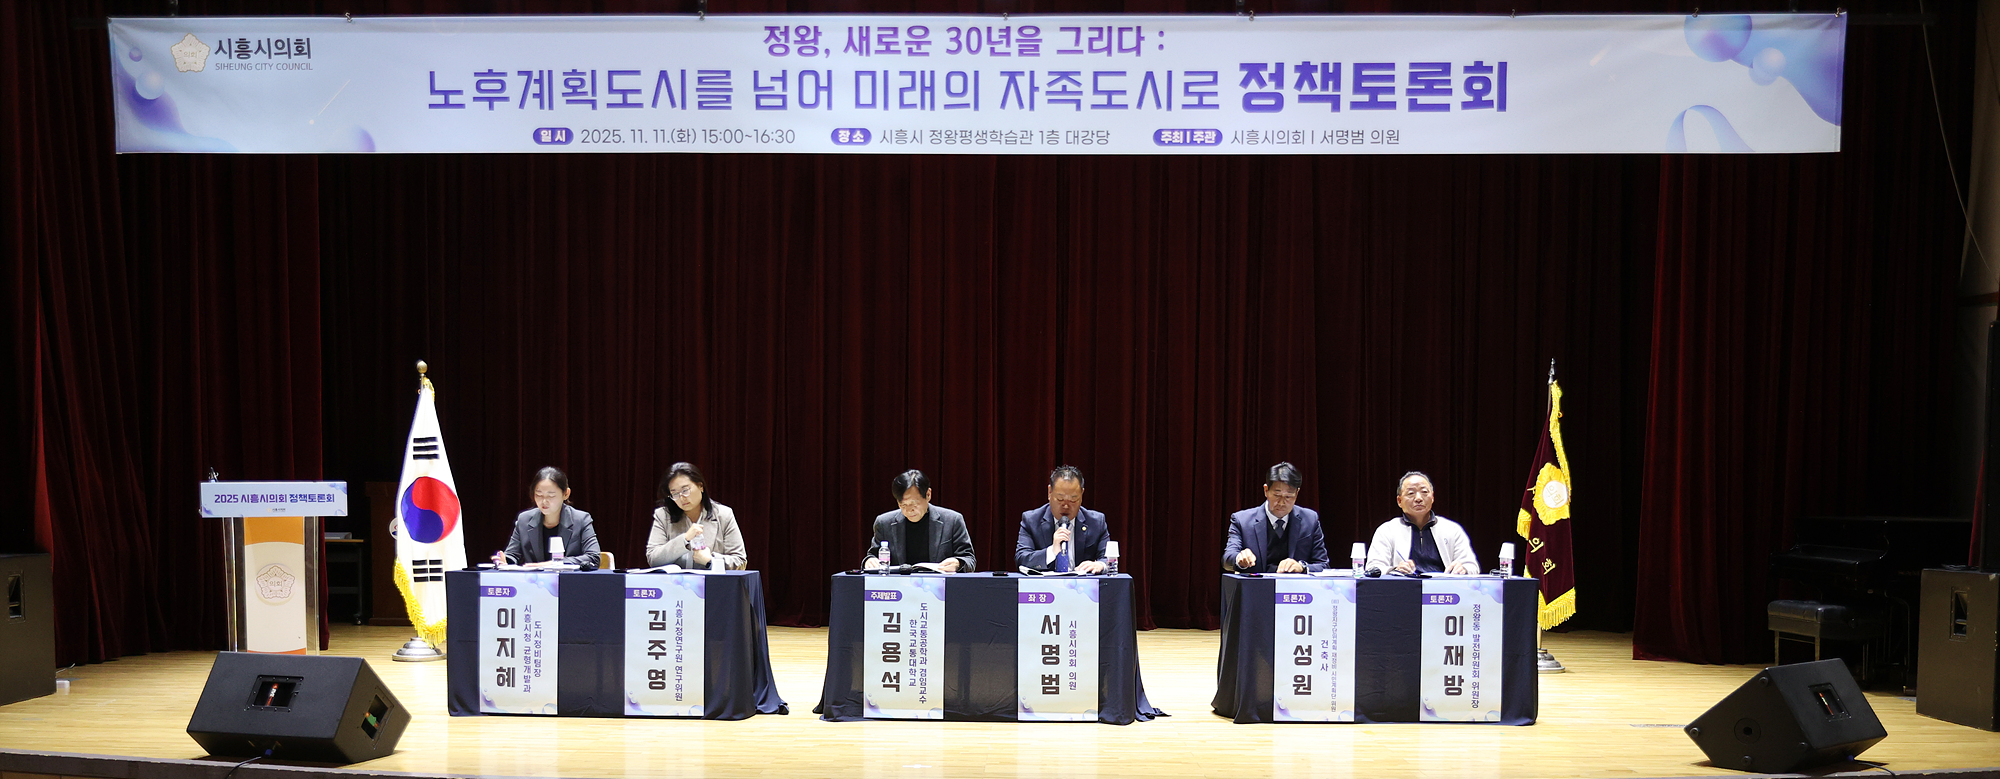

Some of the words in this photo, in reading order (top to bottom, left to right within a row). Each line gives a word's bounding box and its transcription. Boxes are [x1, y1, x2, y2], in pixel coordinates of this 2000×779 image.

[214, 38, 311, 60] 시흥시의회
[763, 25, 830, 58] 정왕,
[843, 25, 932, 57] 새로운
[946, 25, 1043, 57] 30년을
[1057, 25, 1145, 57] 그리다
[428, 69, 733, 111] 노후계획도시를
[753, 70, 834, 112] 넘어
[853, 69, 980, 112] 미래의
[1000, 69, 1220, 112] 자족도시로
[1238, 61, 1508, 113] 정책토론회
[581, 129, 626, 144] 2025.
[630, 129, 648, 143] 11.
[702, 129, 796, 144] 15:00~16:30
[880, 129, 923, 145] 시흥시
[929, 129, 1033, 145] 정왕평생학습관
[1039, 130, 1059, 145] 1층
[1066, 129, 1110, 145] 대강당
[1231, 129, 1305, 145] 시흥시의회
[1320, 129, 1364, 145] 서명범
[1370, 129, 1400, 145] 의원
[214, 494, 239, 503] 2025
[241, 494, 287, 503] 시흥시의회
[289, 494, 335, 503] 정책토론회
[487, 587, 511, 597] 토론자
[633, 589, 656, 599] 토론자
[870, 591, 897, 600] 주제발표
[1282, 594, 1306, 604] 토론자
[1430, 594, 1454, 604] 토론자
[523, 604, 532, 643] 시흥시청
[919, 602, 928, 666] 도시교통공학과
[1472, 603, 1481, 632] 정왕동
[496, 607, 516, 688] 이지혜
[533, 620, 542, 678] 도시정비팀장
[647, 610, 667, 691] 김주영
[881, 612, 901, 693] 김용석
[909, 619, 918, 687] 한국교통대학교
[1040, 614, 1060, 695] 서명범
[1068, 620, 1077, 668] 시흥시의회
[1292, 614, 1313, 696] 이성원
[1320, 639, 1329, 672] 건축사
[1443, 615, 1465, 696] 이재방
[1472, 633, 1481, 679] 발전위원회
[523, 645, 532, 693] 균형개발과
[674, 665, 683, 702] 연구위원
[1068, 671, 1077, 691] 의원
[1471, 681, 1480, 709] 위원장
